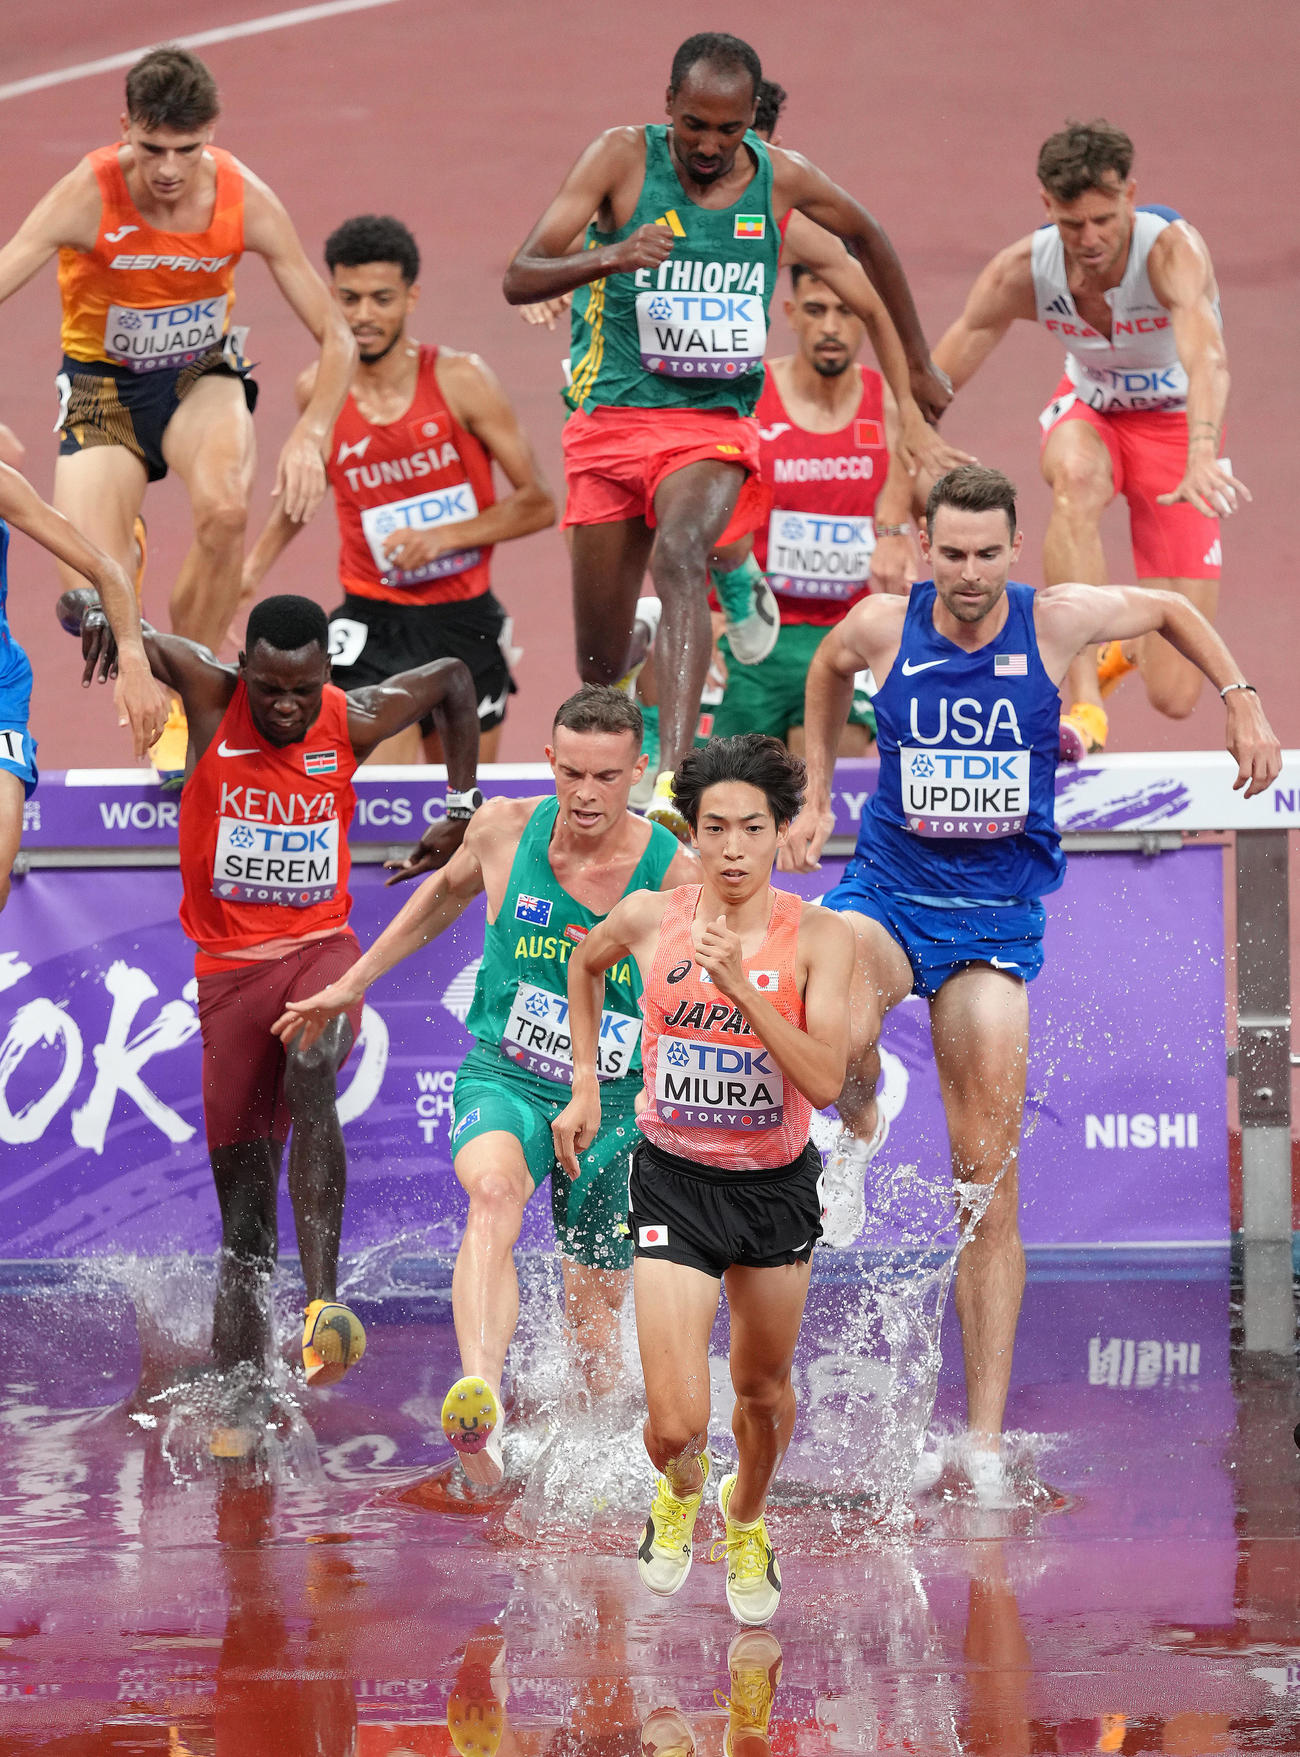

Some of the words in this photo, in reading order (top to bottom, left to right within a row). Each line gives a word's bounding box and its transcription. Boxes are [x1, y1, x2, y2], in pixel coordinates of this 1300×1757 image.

[635, 260, 765, 295] ETHIOPIA
[144, 301, 218, 330] TDK
[673, 297, 753, 322] TDK
[113, 324, 216, 355] QUIJADA
[656, 327, 749, 352] WALE
[1103, 367, 1177, 392] TDK
[344, 442, 461, 492] TUNISIA
[774, 455, 874, 483] MOROCCO
[396, 490, 467, 527] TDK
[807, 520, 867, 544] TDK
[910, 697, 1023, 746] USA
[935, 755, 1018, 780] TDK
[220, 782, 336, 824] KENYA
[910, 784, 1020, 813] UPDIKE
[100, 801, 180, 829] WOR
[256, 827, 330, 853] TDK
[224, 854, 330, 883] SEREM
[552, 998, 631, 1045] TK
[689, 1043, 773, 1075] TDK
[664, 1073, 775, 1108] MIURA
[1085, 1113, 1198, 1149] NISHI
